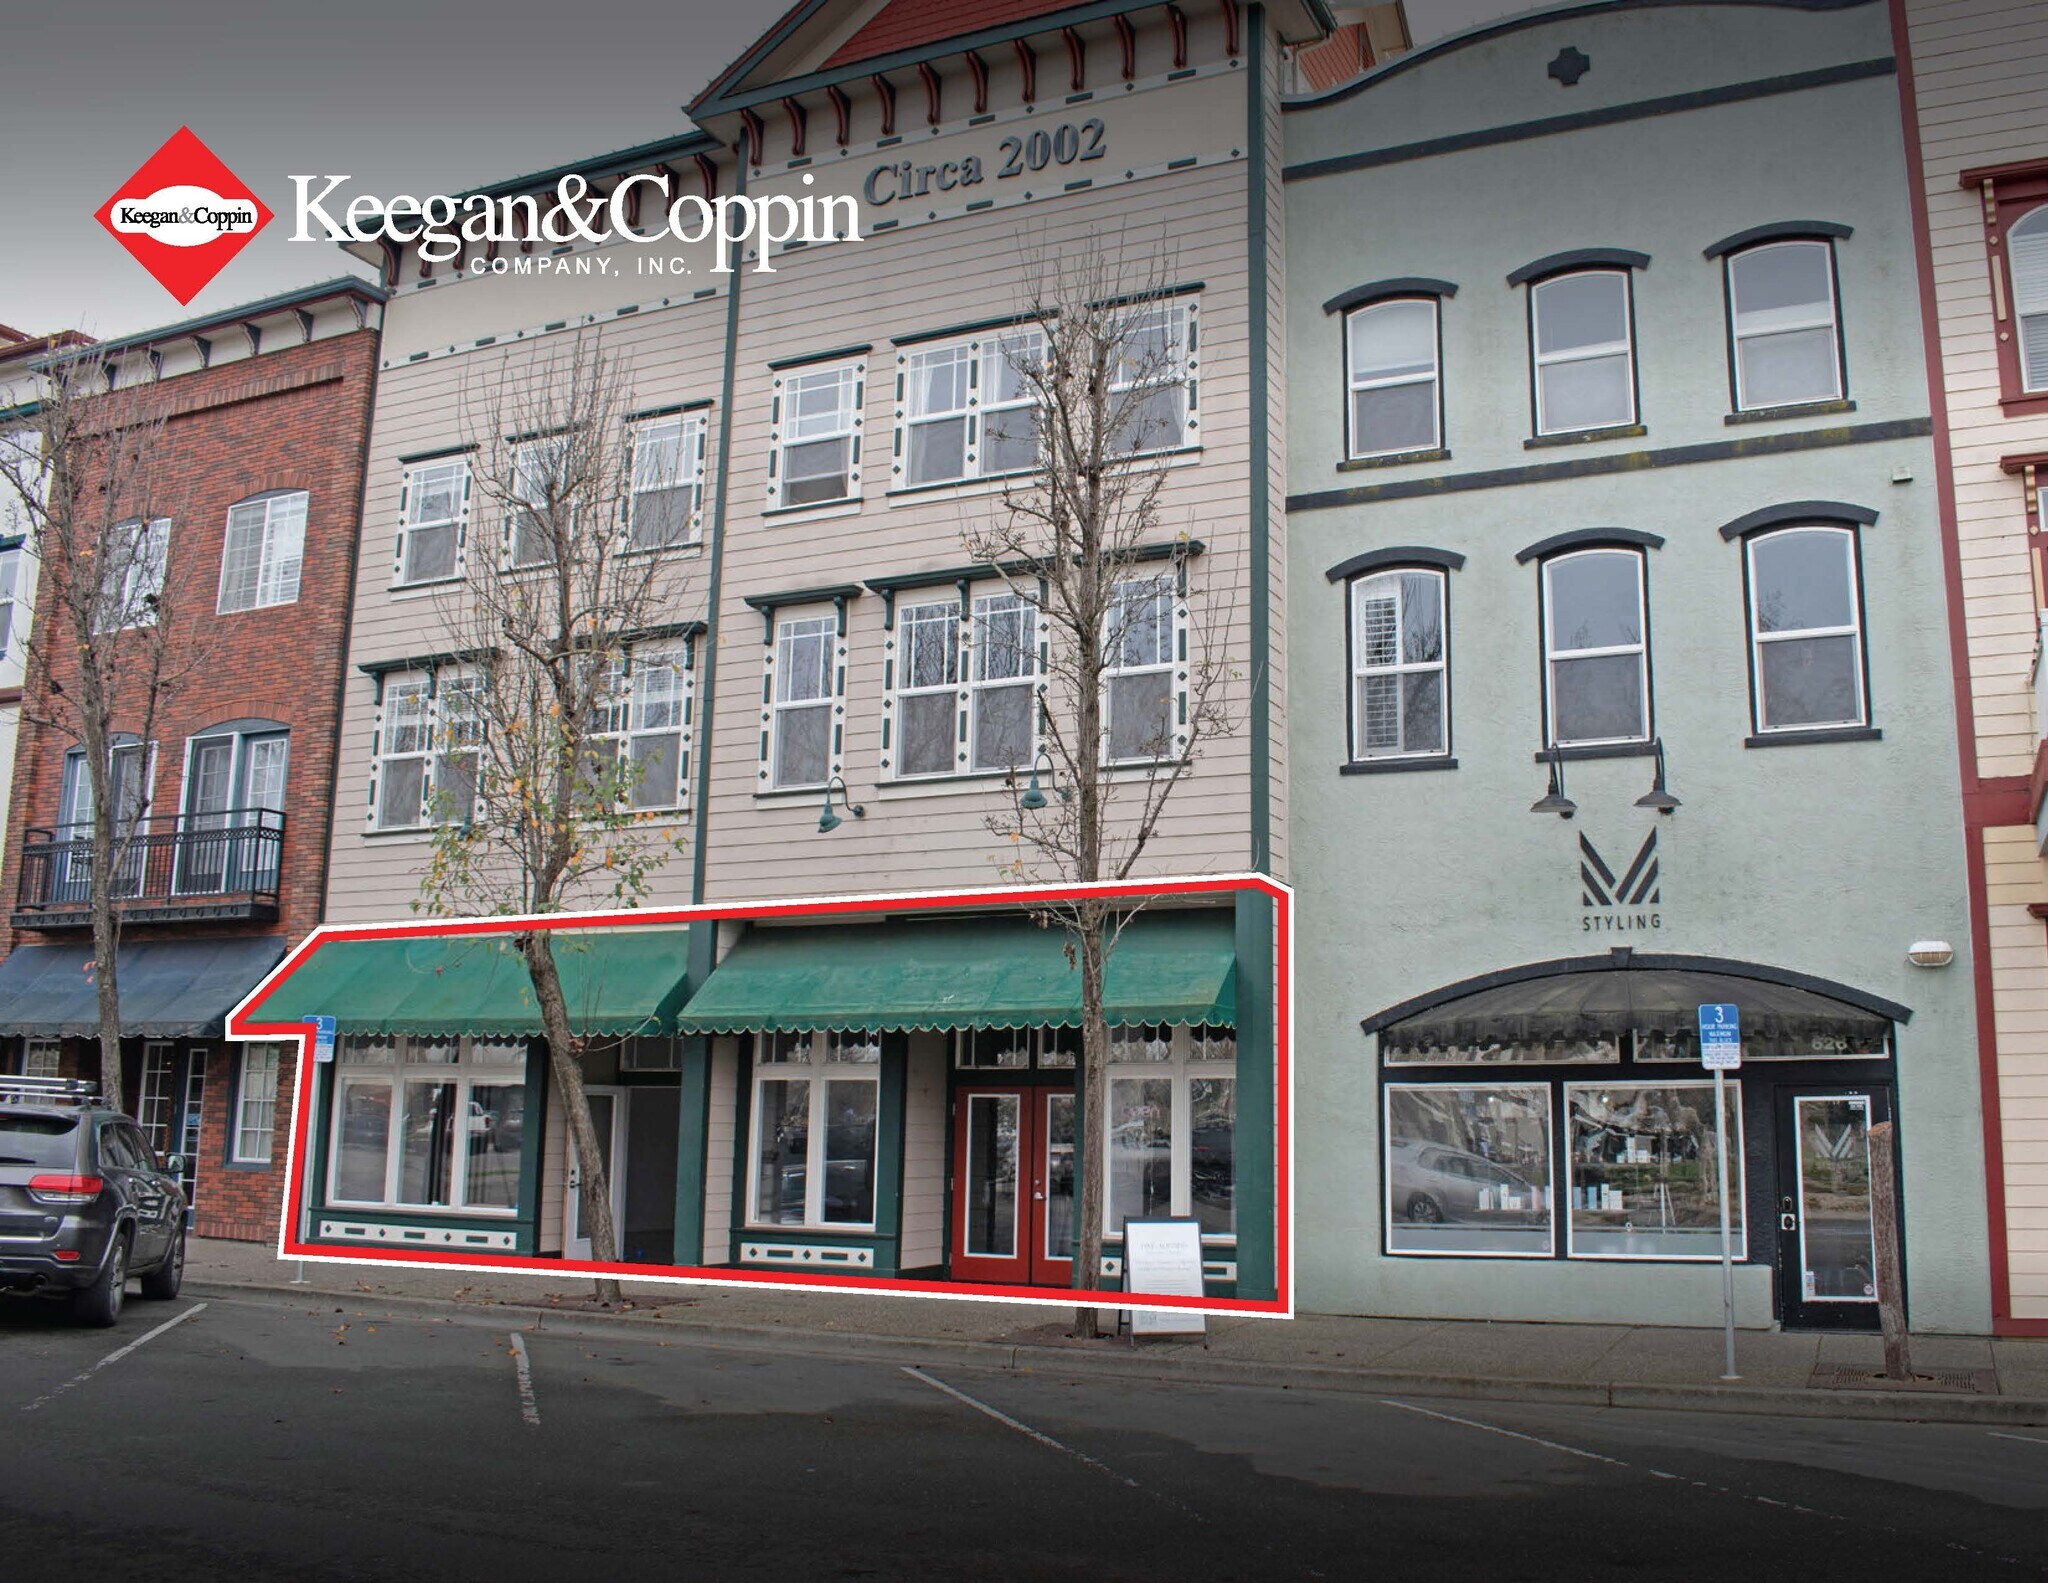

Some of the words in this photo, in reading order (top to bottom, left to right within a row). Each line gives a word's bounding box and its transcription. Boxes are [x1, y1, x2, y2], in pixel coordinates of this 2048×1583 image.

[864, 155, 984, 206] Circa
[997, 118, 1107, 179] 2002
[1582, 914, 1662, 931] STYLING
[1714, 1006, 1724, 1023] 3
[316, 1018, 323, 1029] 3
